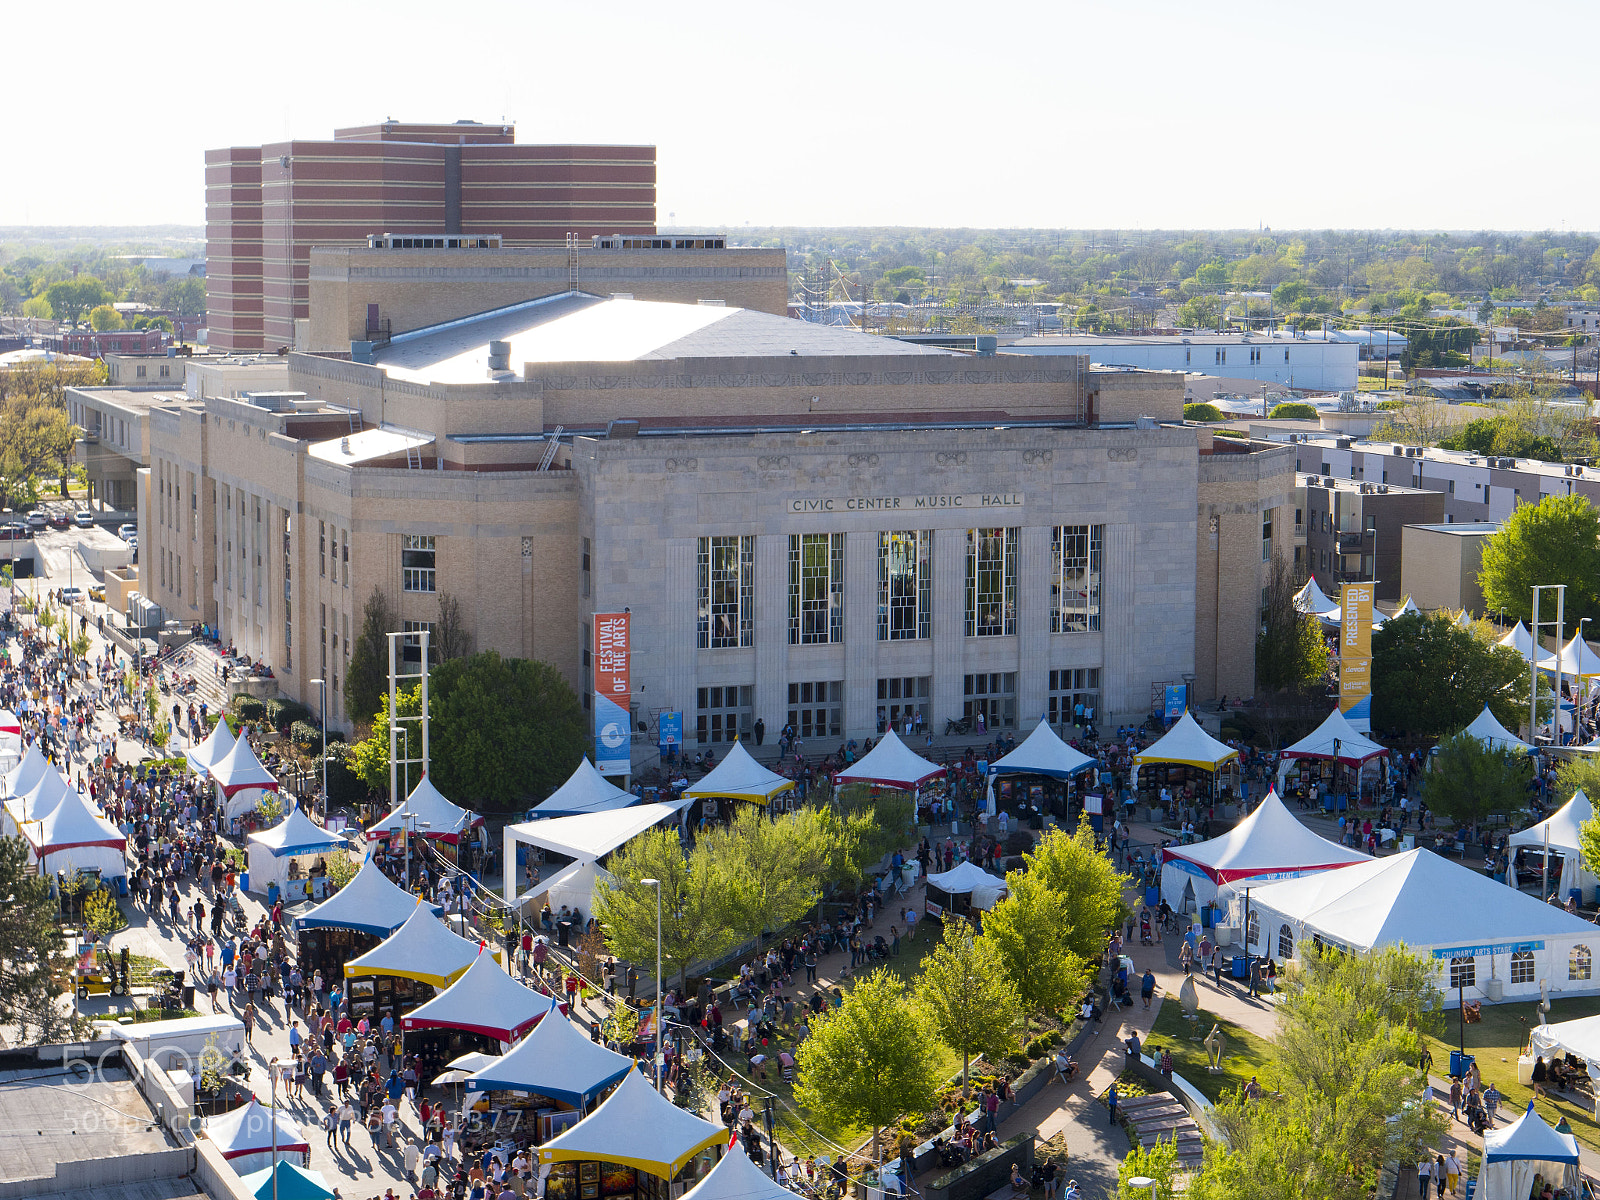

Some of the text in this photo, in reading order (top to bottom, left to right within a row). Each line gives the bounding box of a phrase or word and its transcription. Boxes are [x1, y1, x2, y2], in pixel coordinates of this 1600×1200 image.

[792, 494, 1020, 511] CIVIC CENTER MUSIC HALL
[1359, 588, 1370, 602] BY
[1346, 588, 1358, 646] PRESENTED
[600, 618, 613, 673] FESTIVAL
[612, 618, 626, 692] OF THE ARTS
[1278, 872, 1294, 880] TENT
[1442, 949, 1473, 958] CULINARY
[1474, 947, 1491, 956] ARTS
[1492, 945, 1512, 955] STAGE
